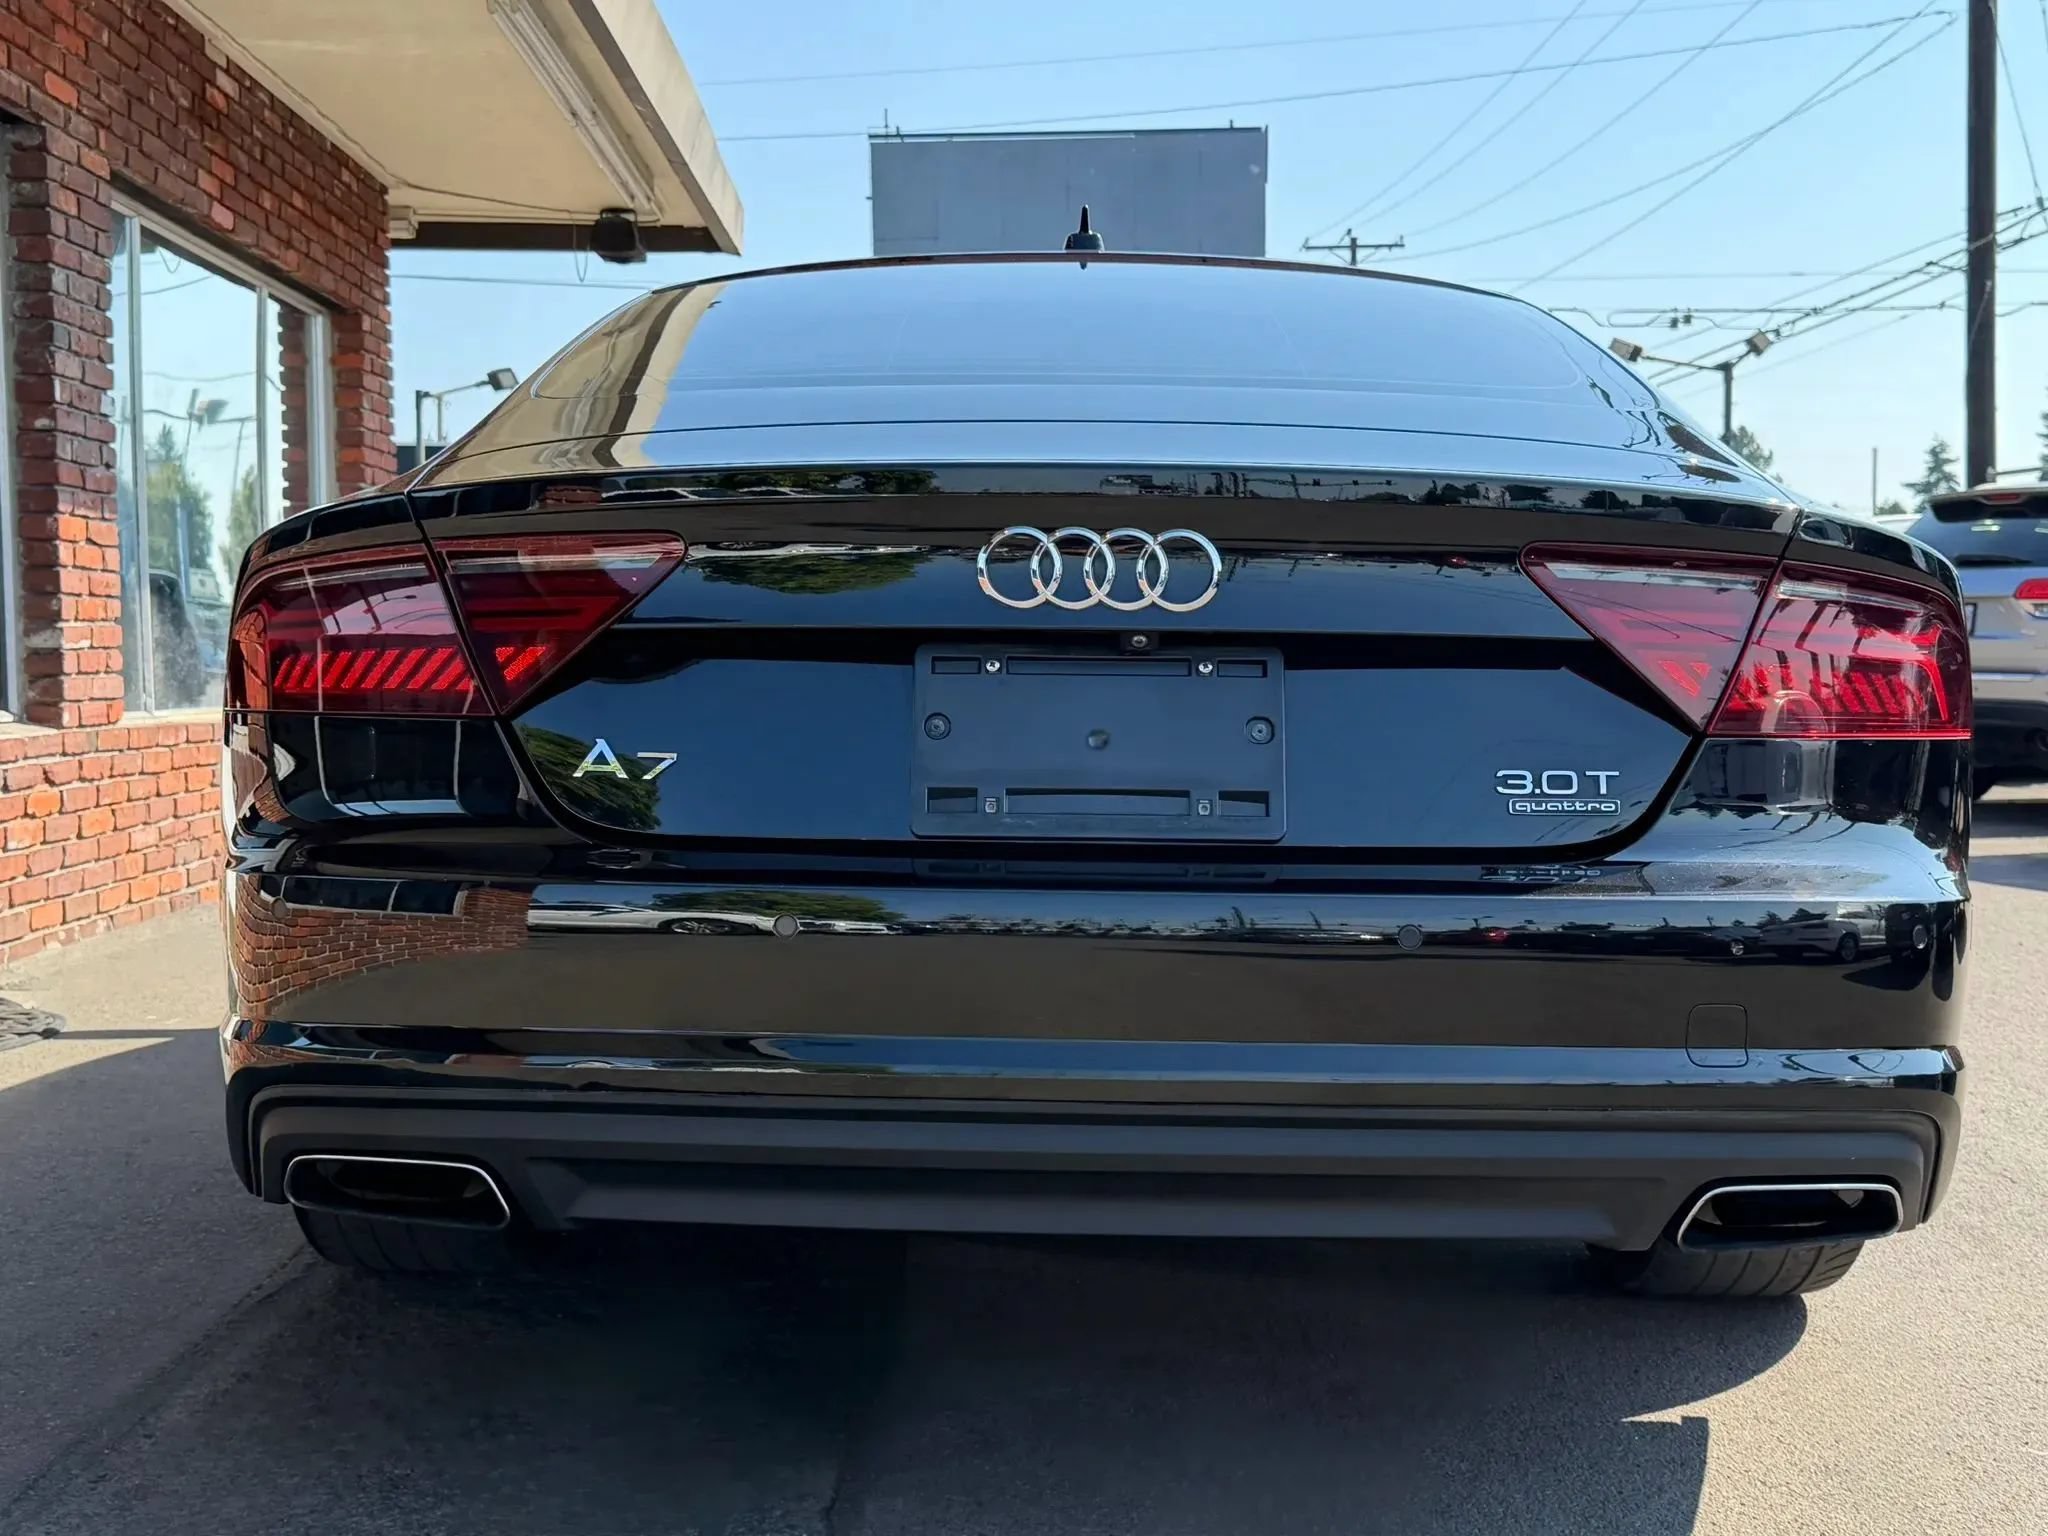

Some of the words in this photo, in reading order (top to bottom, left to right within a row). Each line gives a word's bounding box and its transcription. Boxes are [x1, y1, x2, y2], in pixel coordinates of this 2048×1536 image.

[572, 738, 678, 780] A7
[1496, 769, 1620, 795] 3.0T
[1514, 799, 1617, 813] quattro
